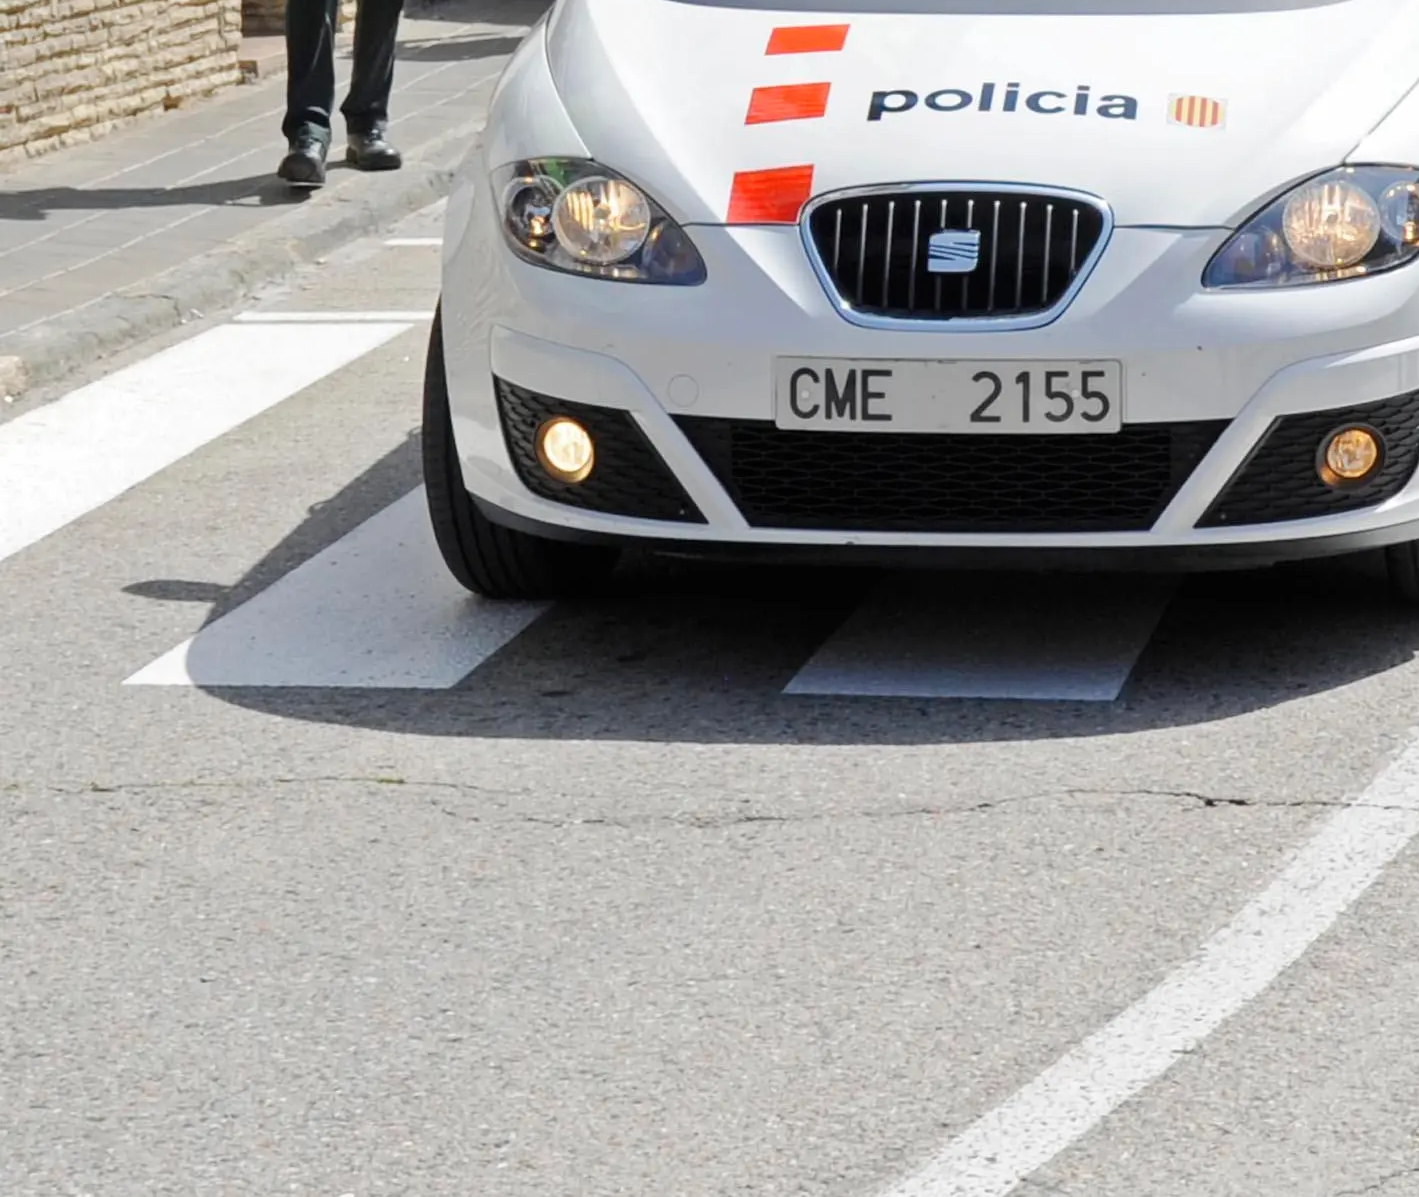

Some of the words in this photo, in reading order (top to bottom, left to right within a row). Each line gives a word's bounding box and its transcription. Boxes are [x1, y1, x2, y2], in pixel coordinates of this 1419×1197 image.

[867, 82, 1138, 121] policia
[790, 367, 893, 420] CME
[969, 370, 1110, 423] 2155
